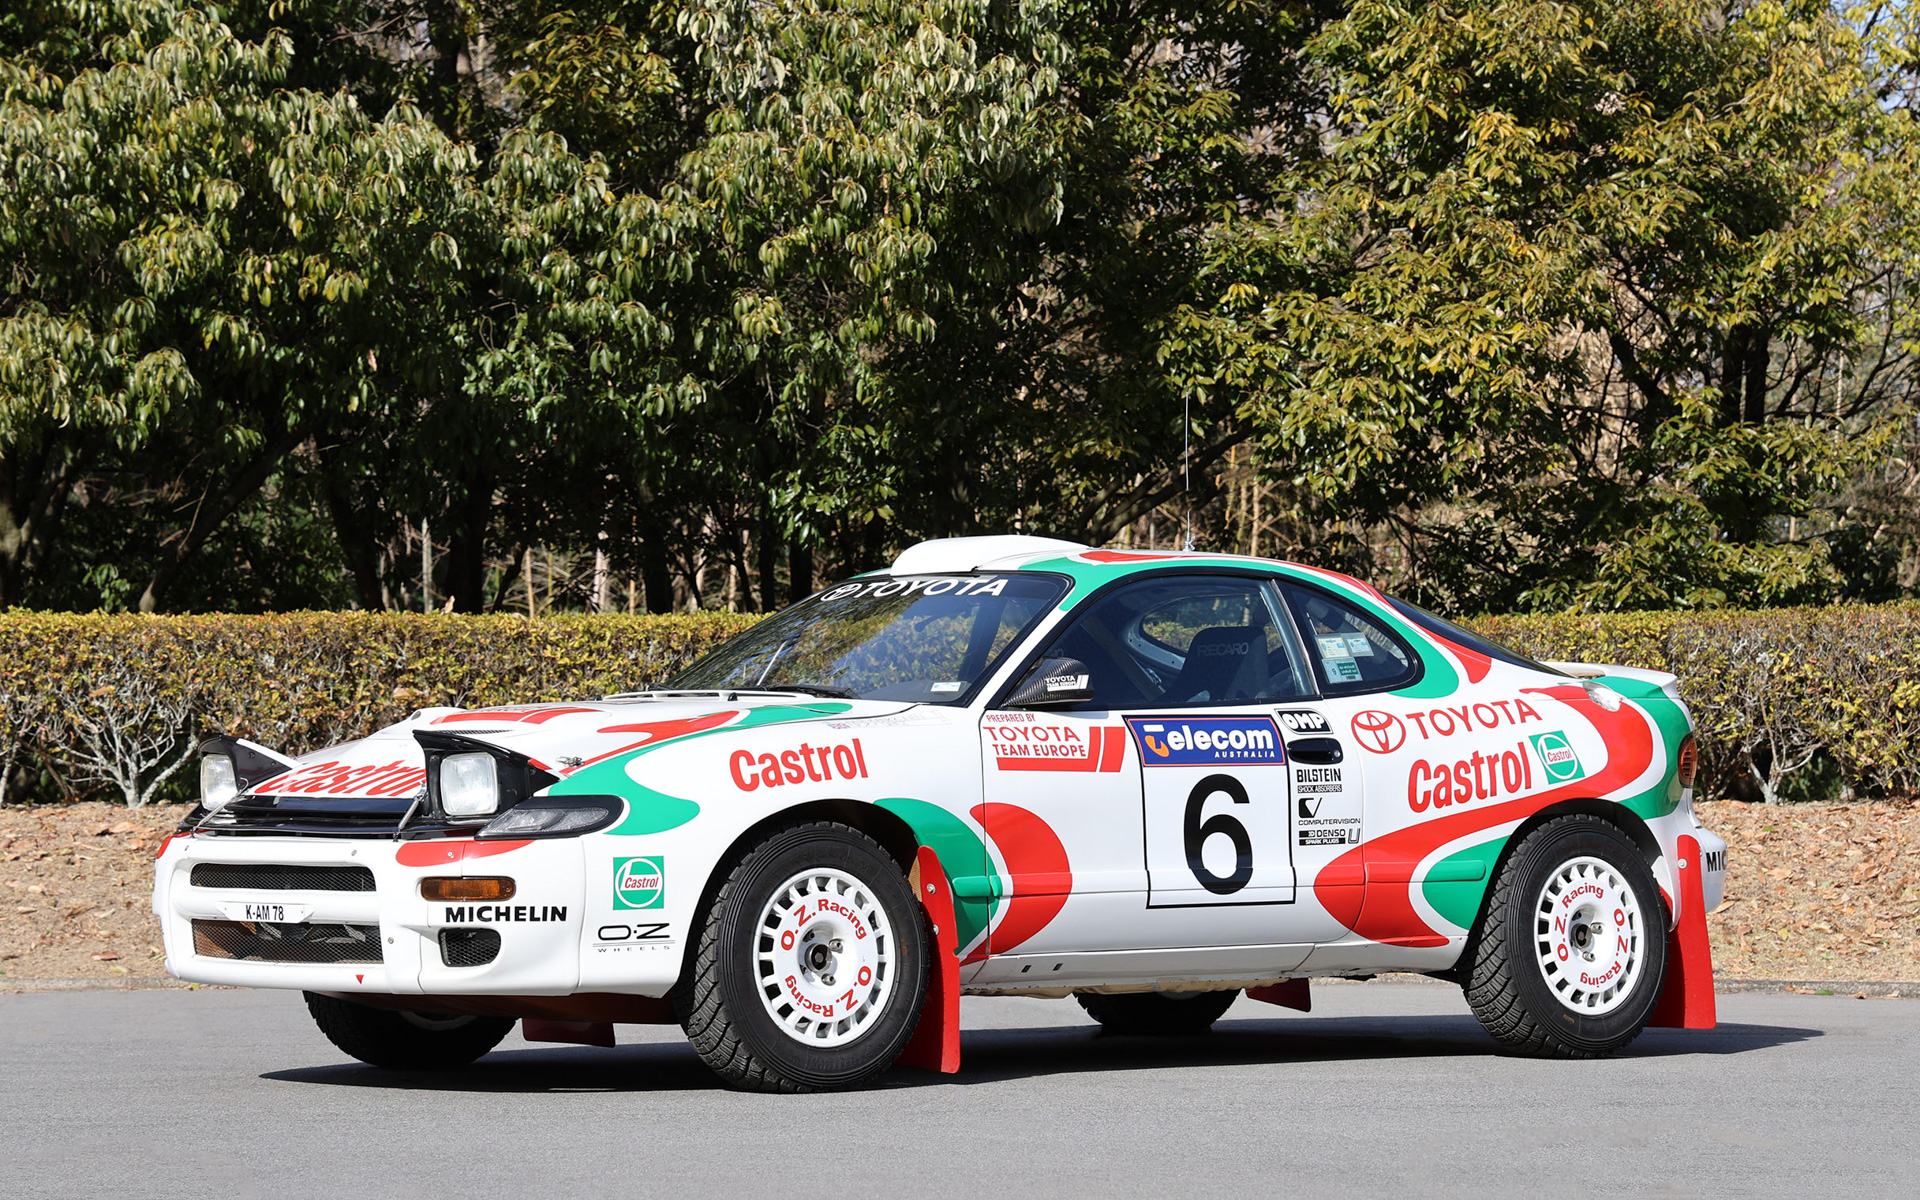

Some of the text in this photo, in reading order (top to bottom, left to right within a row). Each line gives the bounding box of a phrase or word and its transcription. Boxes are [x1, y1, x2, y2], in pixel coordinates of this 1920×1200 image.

[853, 579, 1009, 598] TOYOTA
[1198, 642, 1249, 656] RECARO
[1045, 675, 1076, 684] TOYOTA
[986, 713, 1036, 723] PREPARED BY
[1281, 711, 1325, 730] OMP
[1407, 699, 1542, 740] TOYOTA
[983, 726, 1081, 742] TOYOTA
[1143, 724, 1274, 757] Telecom
[992, 744, 1087, 757] TEAM EUROPE
[1214, 750, 1275, 758] AUSTRALIA
[1547, 748, 1573, 763] Castrol
[729, 738, 869, 792] Castrol
[1296, 768, 1342, 782] BILSTEIN
[1408, 742, 1532, 814] Castrol
[1298, 784, 1342, 793] SHOCK ABSORBERS
[1298, 818, 1361, 826] COMPUTERVISION
[1184, 773, 1254, 895] 6
[1316, 828, 1346, 838] DENSO
[624, 876, 660, 889] Castrol
[1561, 883, 1604, 908] Racing
[245, 905, 284, 921] K-AM 78
[445, 905, 568, 923] MICHELIN
[817, 898, 867, 940] Racing
[597, 945, 671, 953] WHEELS
[1579, 960, 1622, 988] Racing
[784, 974, 834, 1018] Racing
